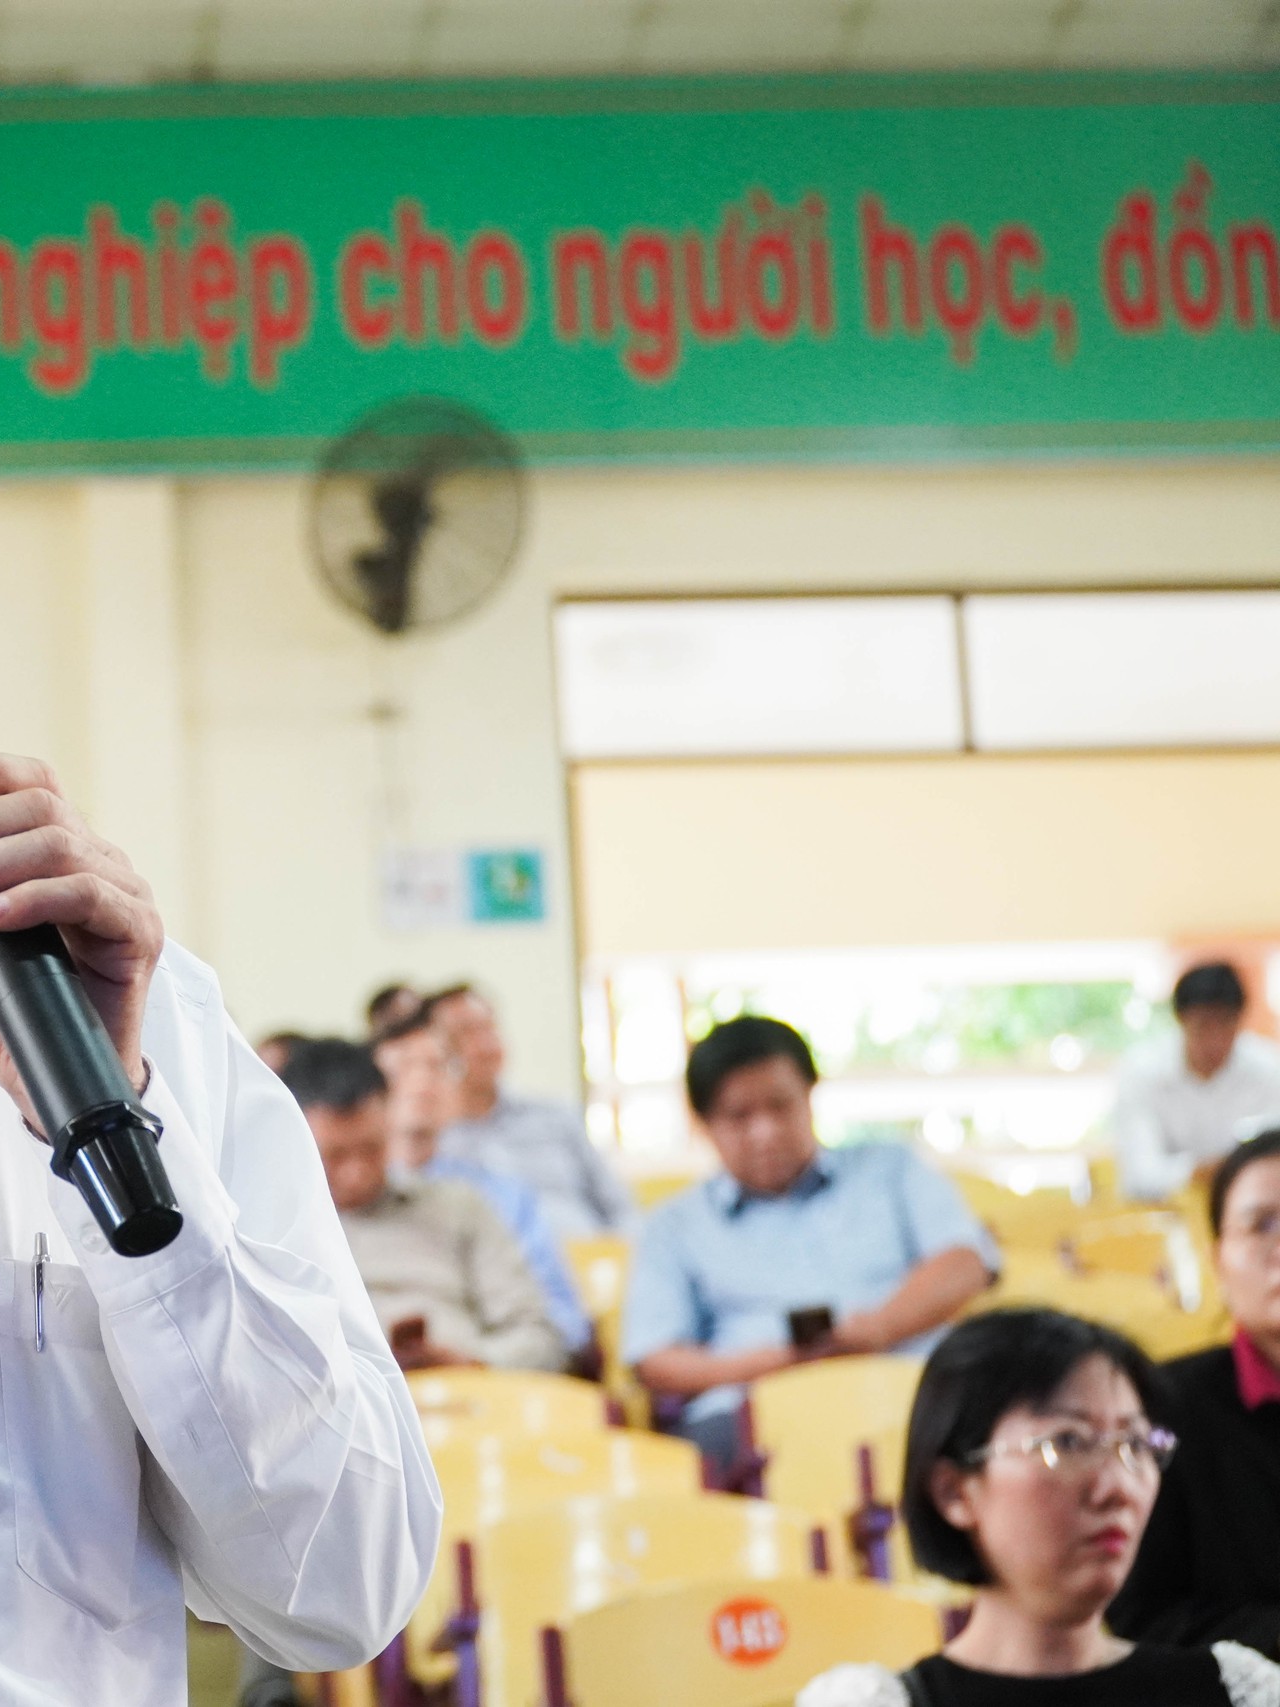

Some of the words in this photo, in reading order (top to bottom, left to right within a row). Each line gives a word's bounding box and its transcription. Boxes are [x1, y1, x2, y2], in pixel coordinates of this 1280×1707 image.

[340, 200, 526, 346] cho
[551, 189, 833, 382] người
[858, 193, 1077, 366] học,
